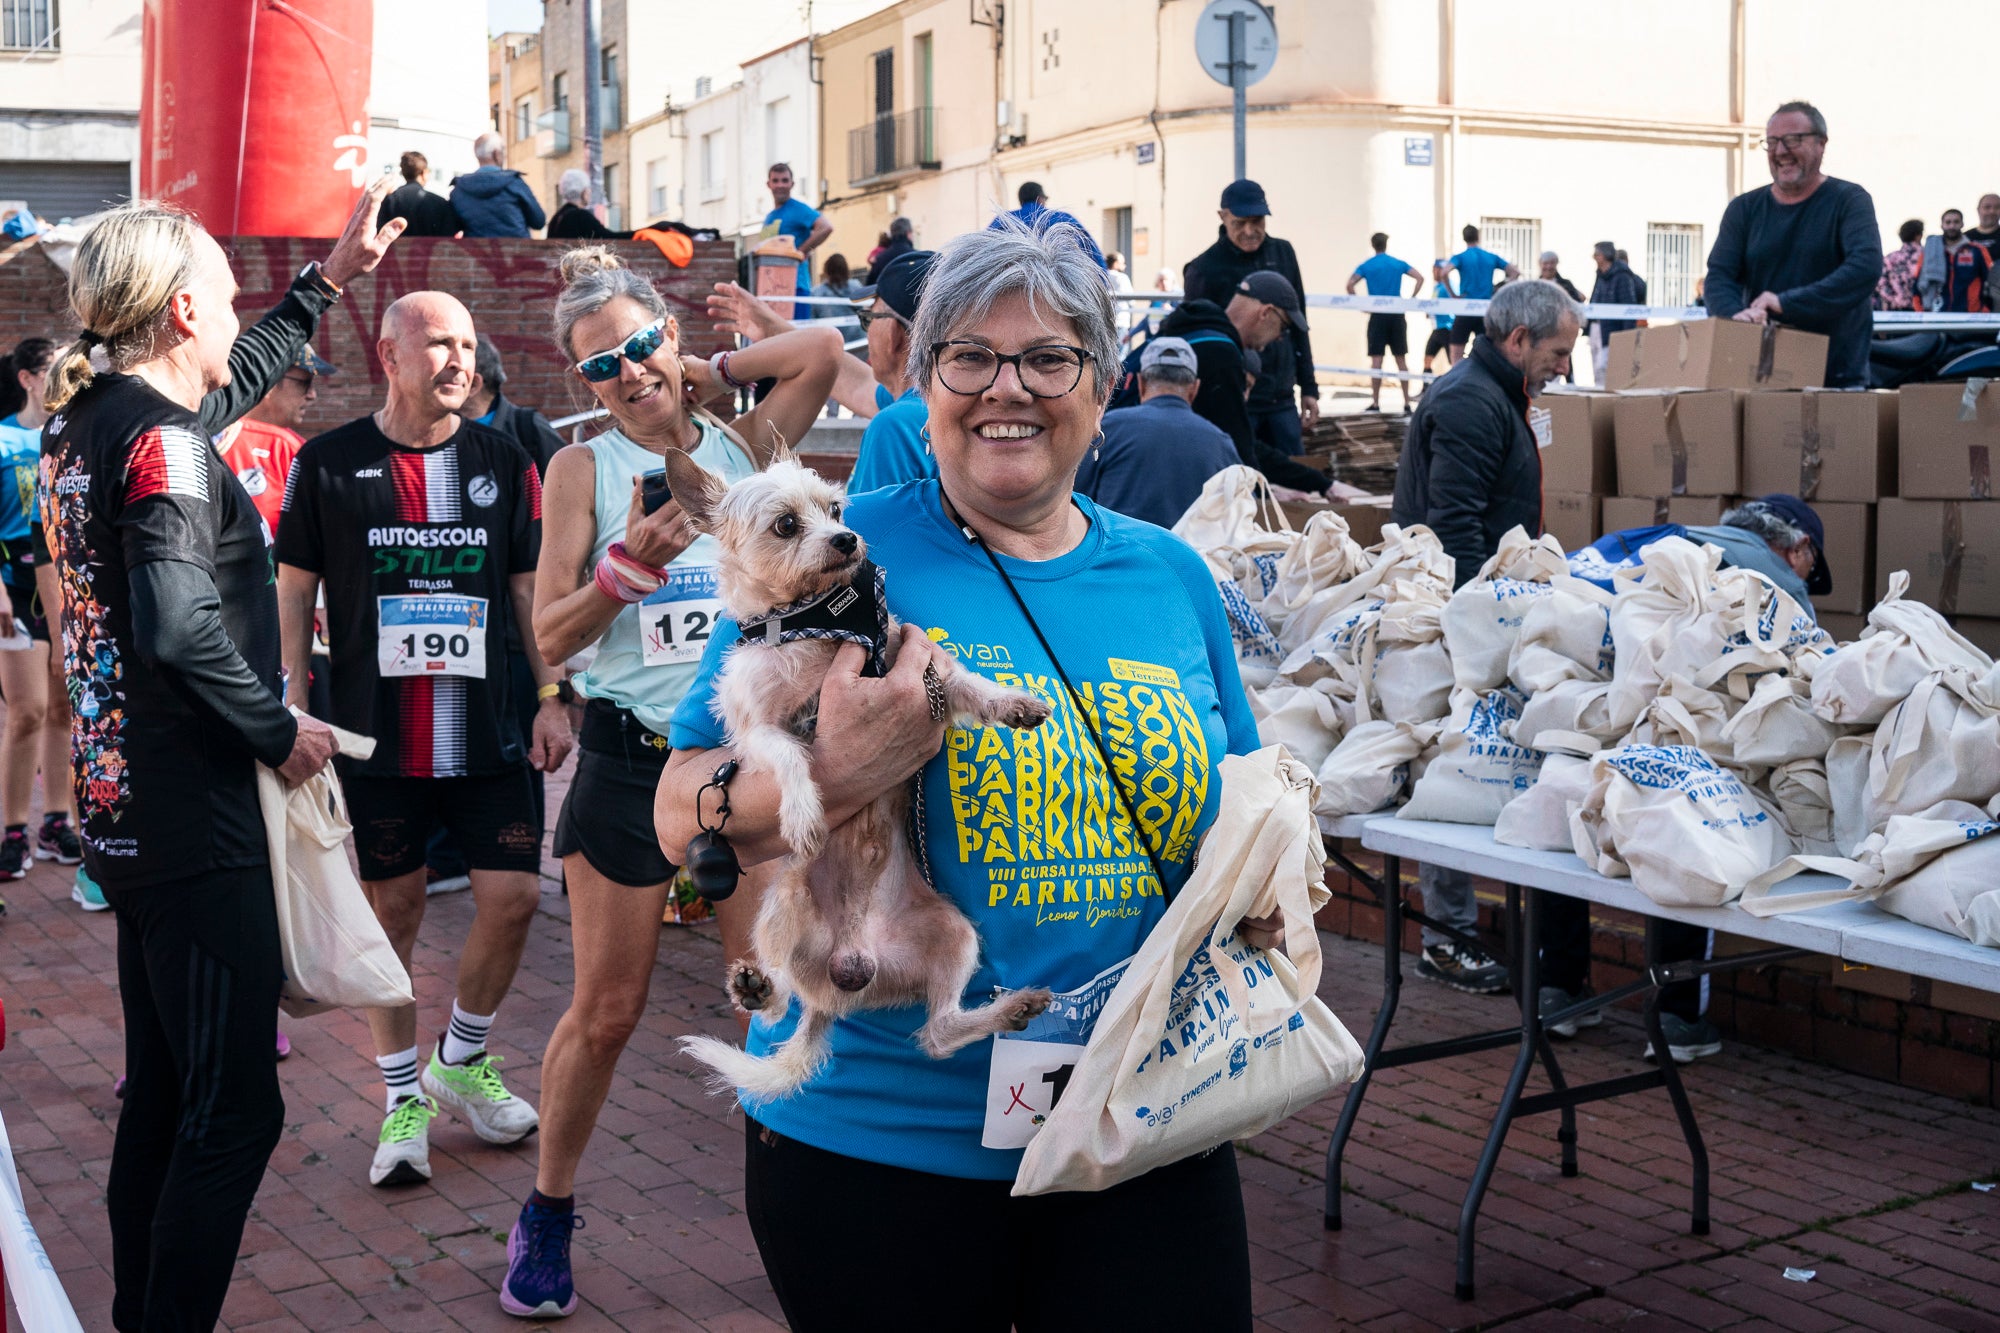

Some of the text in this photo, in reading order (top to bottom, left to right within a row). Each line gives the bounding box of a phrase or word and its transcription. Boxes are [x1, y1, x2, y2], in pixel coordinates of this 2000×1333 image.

[367, 527, 488, 548] AUTOESCOLA
[371, 548, 486, 575] STILO
[665, 574, 718, 587] PARKIN
[401, 603, 469, 612] PARKINSON
[655, 610, 721, 644] 12
[402, 633, 469, 658] 190
[943, 641, 1011, 661] avan
[976, 661, 1014, 669] neurologia
[1130, 669, 1176, 685] Terrassa
[1469, 744, 1543, 761] PARKINS
[988, 868, 1016, 881] VIII
[1021, 864, 1067, 880] CURSA
[1078, 861, 1147, 877] PASSEJADA
[988, 875, 1164, 907] PARKINSON
[1035, 896, 1143, 928] Leonor González
[1164, 996, 1200, 1034] URSA
[1180, 1069, 1222, 1106] SYNERGYM
